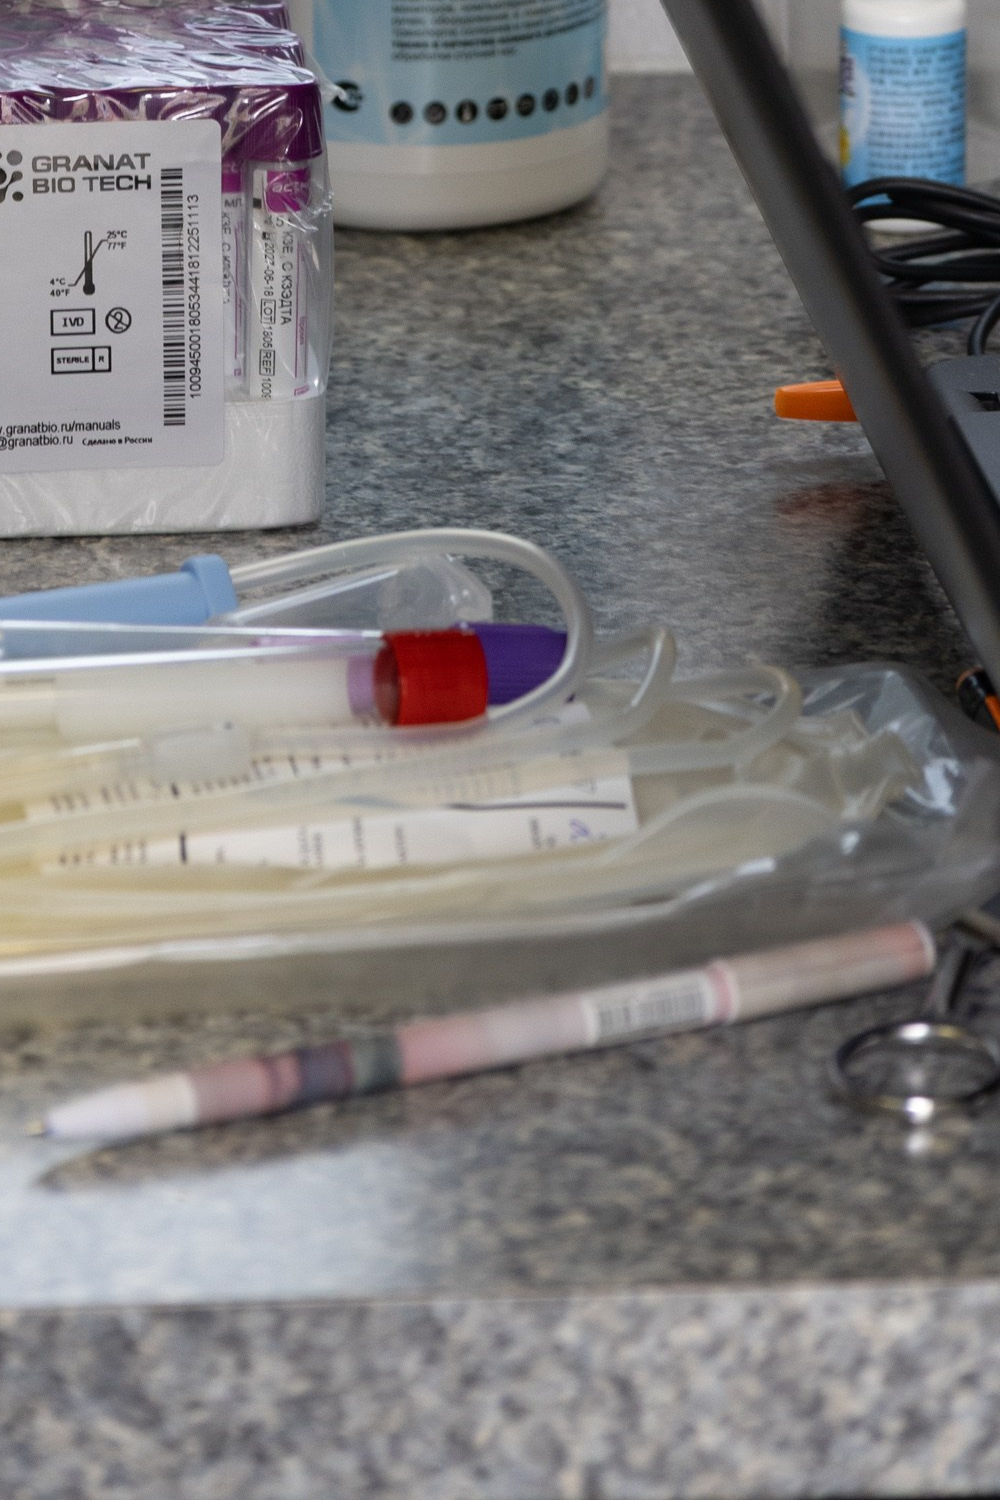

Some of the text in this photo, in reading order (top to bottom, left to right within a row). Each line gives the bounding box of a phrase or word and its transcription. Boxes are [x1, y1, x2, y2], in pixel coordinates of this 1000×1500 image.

[32, 153, 151, 173] GRANAT
[32, 175, 152, 194] BIO TECH
[263, 243, 274, 297] 2027-06-18
[263, 301, 273, 321] LOT
[62, 316, 84, 328] IVD
[262, 326, 273, 349] 1805
[262, 351, 272, 375] REF
[82, 438, 116, 446] Сделано
[125, 436, 153, 444] России
